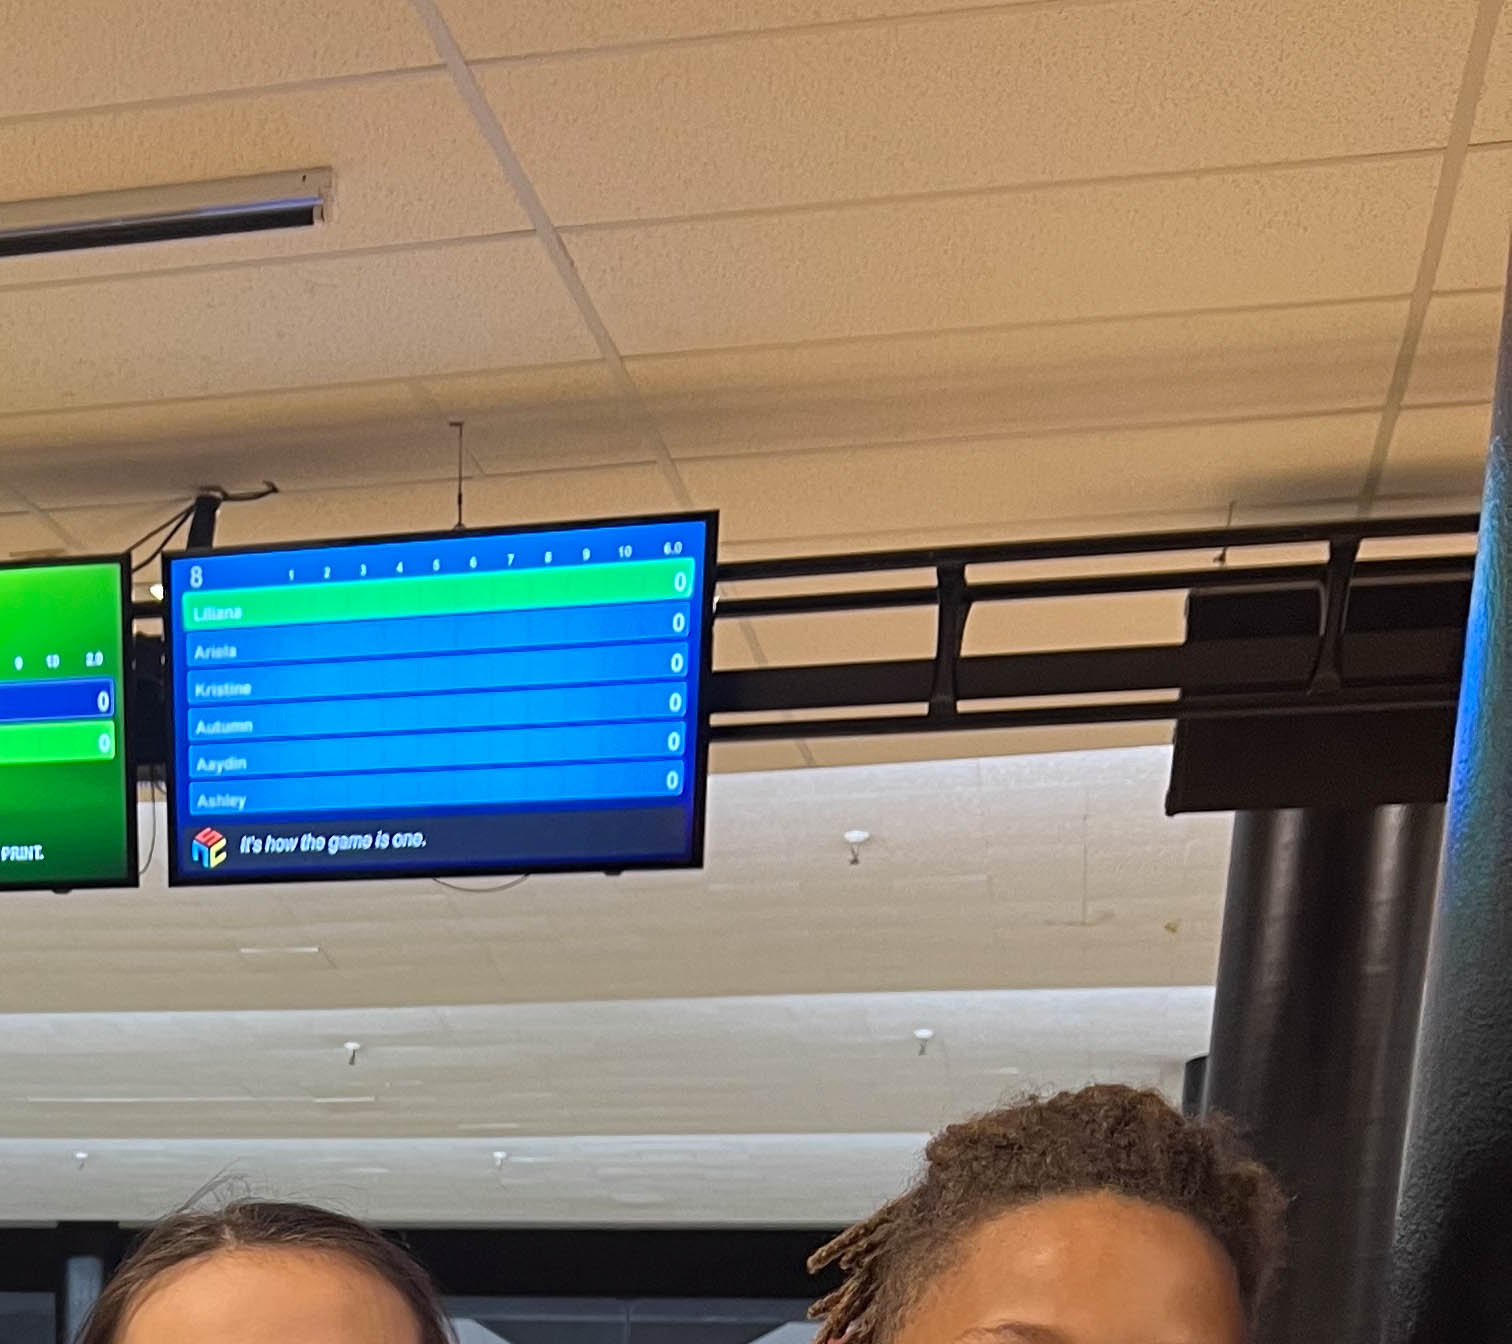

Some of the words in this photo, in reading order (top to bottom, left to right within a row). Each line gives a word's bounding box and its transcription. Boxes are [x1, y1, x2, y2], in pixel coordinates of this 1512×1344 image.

[190, 566, 203, 588] 8
[323, 566, 332, 579] 2
[360, 564, 367, 577] 3
[395, 561, 404, 574] 4
[469, 555, 478, 569] 6
[506, 553, 515, 566] 7
[619, 545, 632, 558] 10
[674, 571, 687, 592] 0
[672, 612, 685, 632] 0
[195, 682, 252, 698] Kristine
[670, 652, 683, 673] 0
[97, 690, 110, 712] 0
[196, 719, 254, 735] Autumn
[669, 692, 682, 713] 0
[98, 732, 111, 754] 0
[667, 731, 680, 751] 0
[666, 770, 679, 790] 0
[240, 834, 263, 855] It's
[264, 834, 299, 854] how
[300, 831, 326, 852] the
[328, 833, 373, 856] game
[375, 830, 391, 849] is
